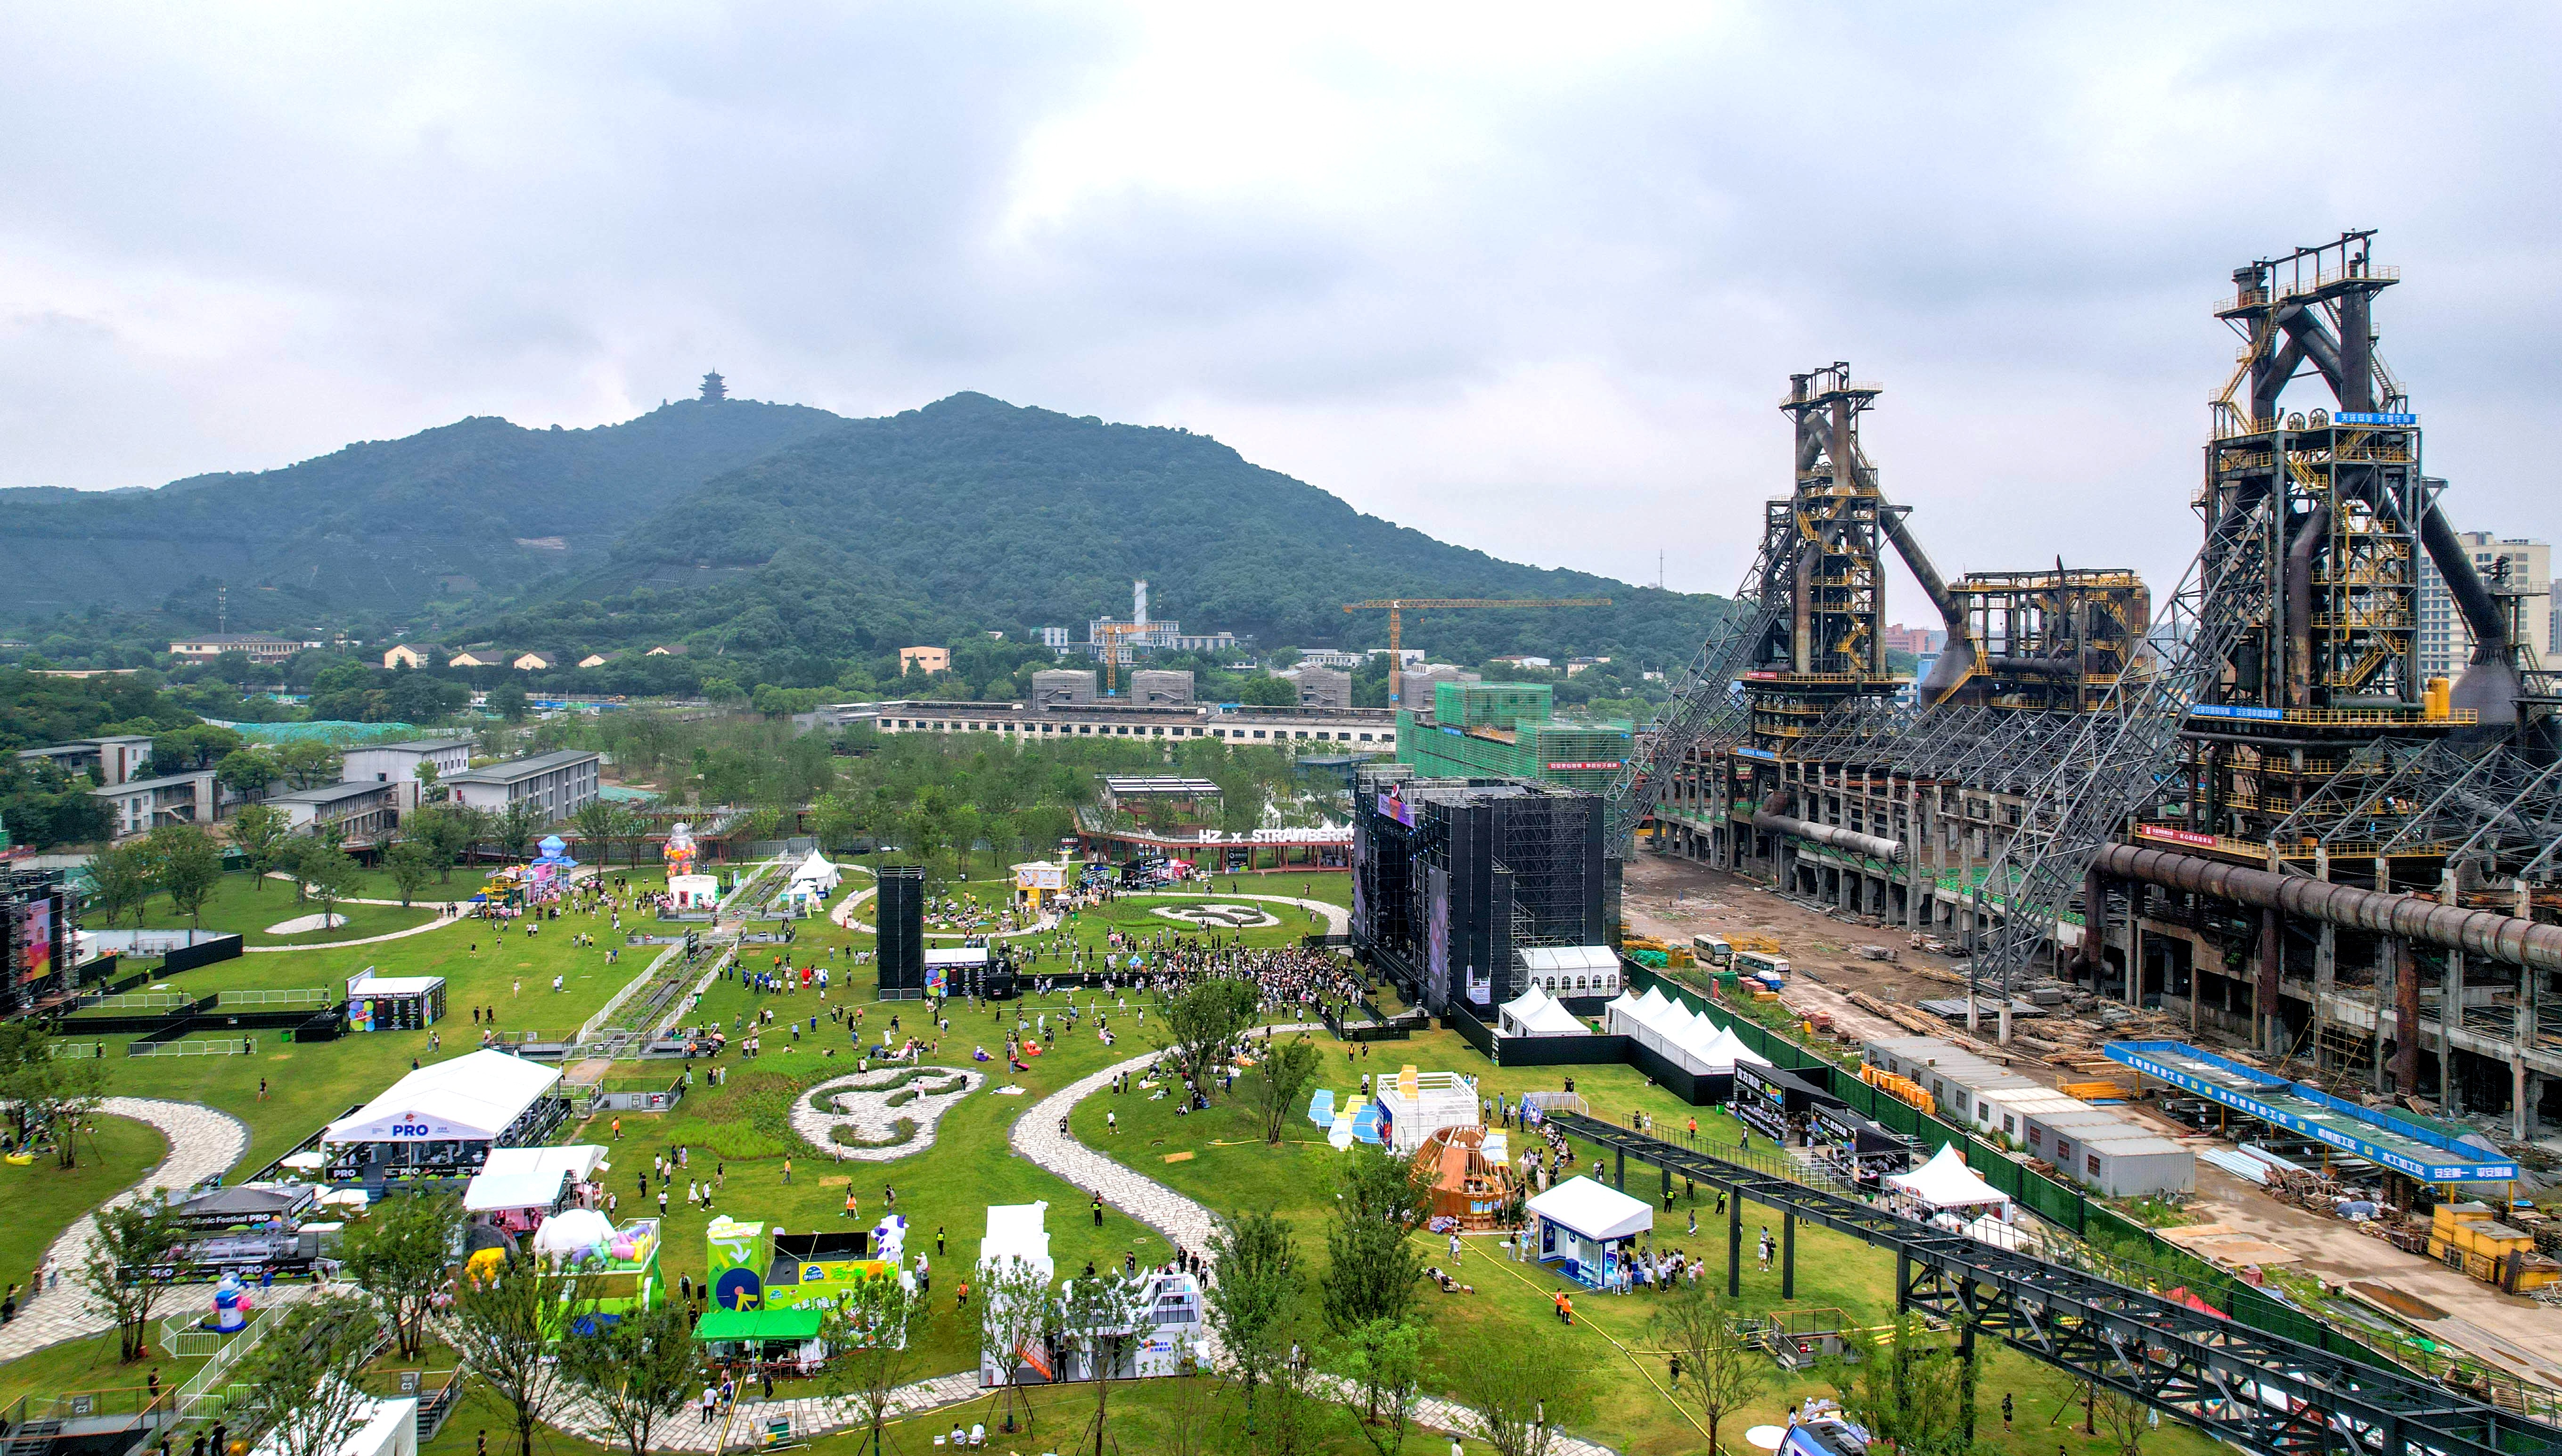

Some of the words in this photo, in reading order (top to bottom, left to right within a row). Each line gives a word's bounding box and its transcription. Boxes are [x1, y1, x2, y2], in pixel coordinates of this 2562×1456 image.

[1198, 829, 1222, 844] HZ
[393, 1124, 429, 1136] PRO
[334, 1169, 356, 1178] PRO
[2434, 1168, 2470, 1178] 安全第一
[216, 1215, 247, 1224] Festival
[249, 1214, 270, 1222] PRO
[238, 1265, 263, 1274] PRO
[401, 1382, 413, 1391] C3
